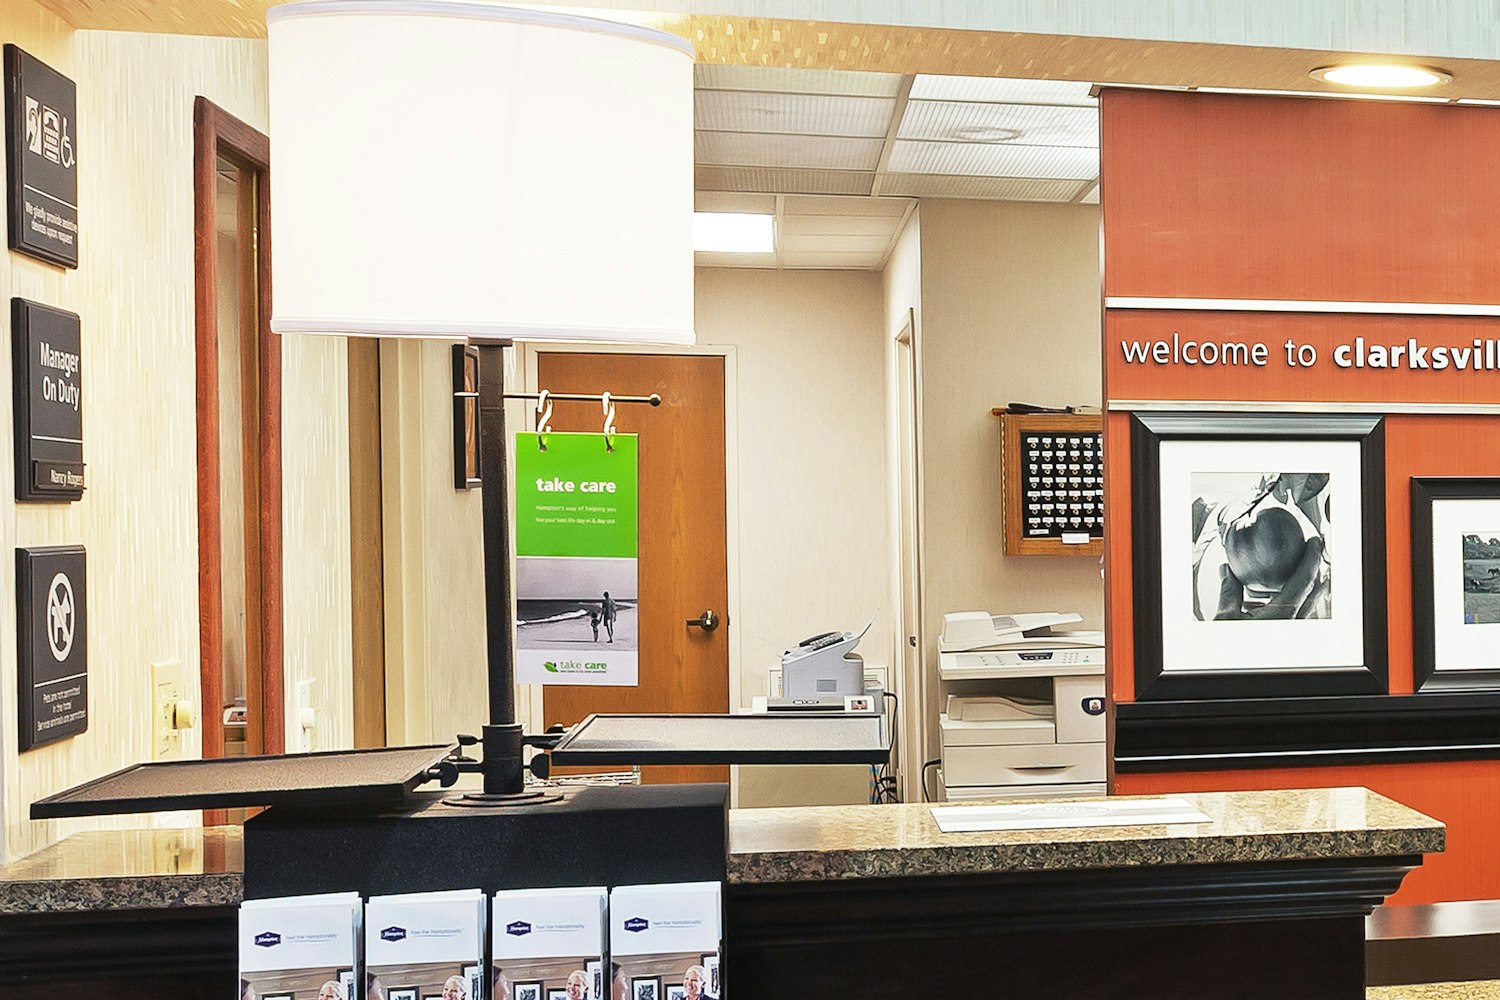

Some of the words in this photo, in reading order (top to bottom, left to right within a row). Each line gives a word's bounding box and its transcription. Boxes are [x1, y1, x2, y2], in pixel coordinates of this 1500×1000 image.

[40, 341, 79, 378] Manager
[1121, 332, 1269, 366] welcome
[1284, 338, 1318, 367] to
[43, 375, 57, 401] On
[58, 378, 80, 412] Duty
[536, 477, 575, 493] take
[579, 481, 617, 493] care
[560, 660, 582, 669] take
[584, 662, 607, 670] care
